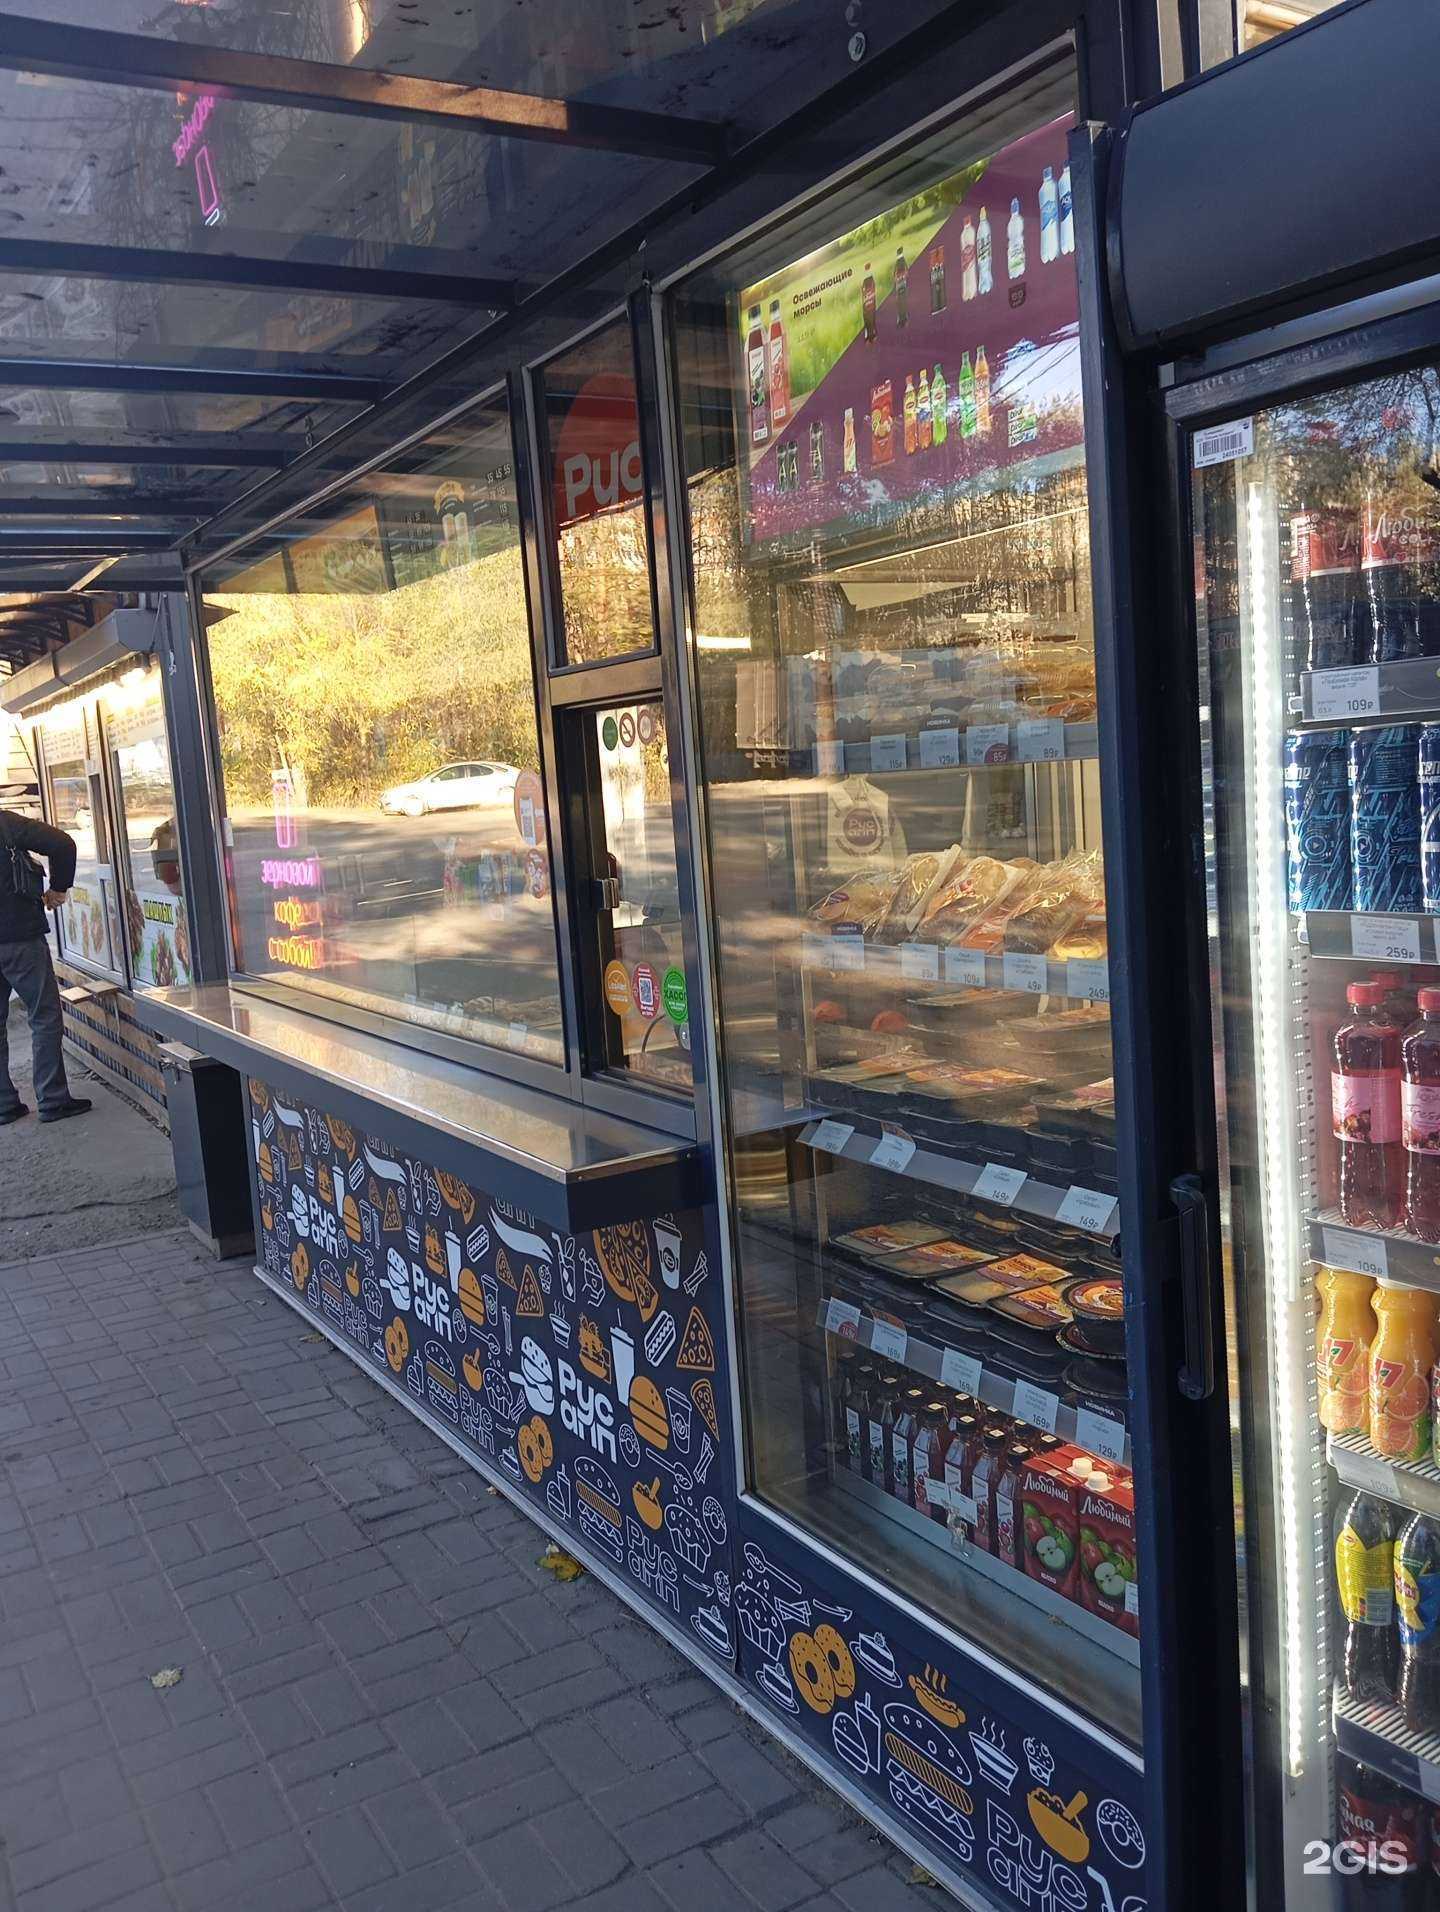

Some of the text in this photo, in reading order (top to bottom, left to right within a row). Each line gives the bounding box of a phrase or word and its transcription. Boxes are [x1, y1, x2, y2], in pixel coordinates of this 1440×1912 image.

[792, 268, 853, 305] Освежающие
[793, 299, 822, 319] морсы
[1347, 699, 1374, 711] 109₽
[1385, 946, 1415, 959] 259₽
[1358, 1260, 1383, 1275] 109₽
[412, 1262, 450, 1313] Рус
[558, 1357, 615, 1427] Рус
[1022, 1472, 1070, 1503] Любимый
[1080, 1495, 1131, 1529] Любимый
[626, 1515, 678, 1582] Рус
[987, 1798, 1088, 1910] Рус
